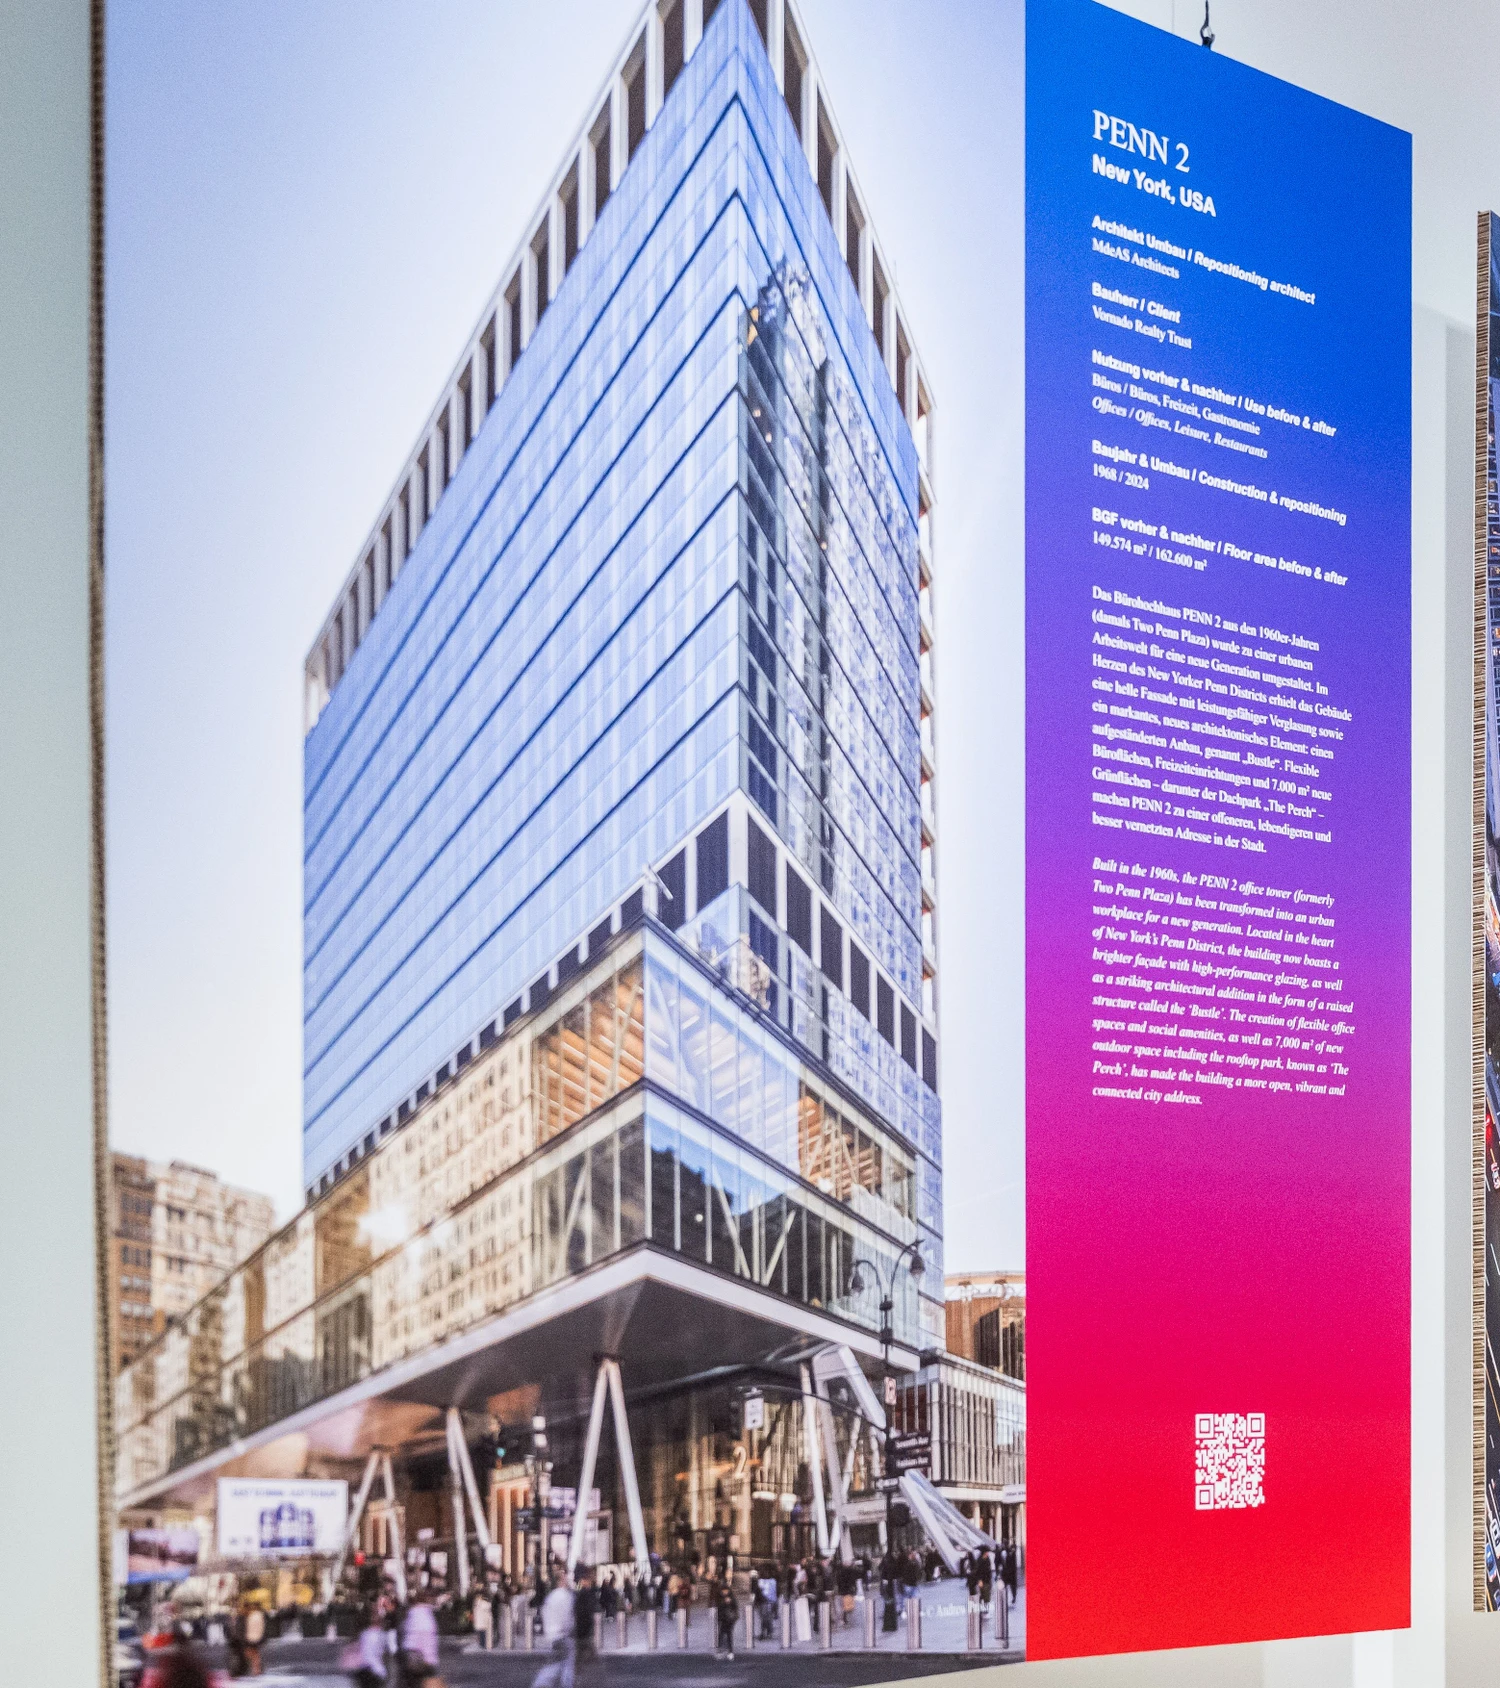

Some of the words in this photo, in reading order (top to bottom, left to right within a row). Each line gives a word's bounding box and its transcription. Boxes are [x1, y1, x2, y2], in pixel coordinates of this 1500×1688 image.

[1093, 109, 1169, 165] PENN
[1175, 142, 1190, 173] 2
[1093, 153, 1130, 184] New
[1133, 168, 1176, 205] York,
[1180, 186, 1216, 217] USA
[1092, 215, 1145, 245] Architekt
[1146, 233, 1186, 260] Umbau
[1194, 251, 1268, 291] Repositioning
[1270, 280, 1315, 305] architect
[1131, 252, 1179, 279] Architects
[1092, 282, 1139, 309] Bauherr
[1147, 301, 1181, 324] Client
[1092, 305, 1133, 330] Vornado
[1135, 319, 1166, 343] Realty
[1167, 329, 1192, 349] Trust
[1092, 349, 1140, 380] Nutzung
[1142, 368, 1179, 388] vorher
[1180, 377, 1190, 392] &
[1192, 384, 1237, 406] nachher
[1244, 397, 1266, 415] Use
[1266, 404, 1301, 426] before
[1302, 416, 1311, 430] &
[1312, 420, 1337, 437] after
[1092, 373, 1122, 394] Büros
[1129, 384, 1161, 407] Büros,
[1163, 394, 1201, 419] Freizeit,
[1202, 407, 1260, 435] Gastronomie
[1092, 396, 1127, 417] Offices
[1135, 409, 1172, 432] Offices,
[1174, 420, 1211, 443] Leisure,
[1213, 432, 1268, 459] Restaurants
[1092, 439, 1137, 464] Baujahr
[1139, 453, 1149, 468] &
[1150, 456, 1190, 480] Umbau
[1198, 470, 1268, 501] Construction
[1269, 491, 1278, 504] &
[1279, 496, 1347, 526] repositioning
[1093, 463, 1117, 481] 1968
[1124, 472, 1149, 490] 2024
[1092, 507, 1118, 526] BGF
[1120, 517, 1158, 536] vorher
[1159, 525, 1169, 540] &
[1171, 531, 1216, 552] nachher
[1223, 542, 1253, 561] Floor
[1253, 553, 1277, 568] area
[1278, 557, 1312, 577] before
[1313, 566, 1322, 580] &
[1324, 570, 1348, 586] after
[1093, 531, 1132, 552] 149.574
[1091, 609, 1131, 629] (damals
[1132, 617, 1154, 634] Two
[1155, 623, 1179, 640] Penn
[1181, 629, 1210, 649] Plaza)
[1211, 639, 1240, 654] wurde
[1241, 646, 1253, 657] zu
[1254, 647, 1277, 662] einer
[1278, 654, 1313, 671] urbanen
[1092, 585, 1112, 602] Das
[1114, 590, 1181, 619] Bürohochhaus
[1183, 607, 1213, 626] PENN
[1215, 615, 1221, 628] 2
[1222, 620, 1239, 632] aus
[1239, 622, 1257, 637] den
[1259, 626, 1319, 651] 1960er-Jahren
[1092, 631, 1148, 655] Arbeitswelt
[1150, 644, 1165, 659] für
[1165, 648, 1186, 663] eine
[1187, 655, 1210, 669] neue
[1211, 658, 1261, 680] Generation
[1262, 672, 1314, 692] umgestaltet.
[1316, 681, 1328, 696] Im
[1092, 653, 1127, 673] Herzen
[1128, 662, 1146, 677] des
[1147, 665, 1170, 681] New
[1171, 671, 1204, 689] Yorker
[1205, 678, 1228, 695] Penn
[1230, 683, 1267, 703] Districts
[1268, 694, 1297, 710] erhielt
[1298, 699, 1313, 713] das
[1314, 703, 1352, 721] Gebäude
[1092, 857, 1118, 872] Built
[1119, 862, 1130, 874] in
[1131, 863, 1147, 877] the
[1149, 866, 1180, 883] 1960s,
[1182, 871, 1198, 885] the
[1199, 874, 1230, 890] PENN
[1230, 879, 1237, 891] 2
[1239, 881, 1264, 896] office
[1266, 886, 1292, 899] tower
[1293, 889, 1335, 909] (formerly
[1093, 879, 1114, 894] Two
[1115, 883, 1141, 898] Penn
[1142, 887, 1174, 905] Plaza)
[1176, 892, 1193, 906] has
[1195, 895, 1217, 910] been
[1219, 901, 1275, 918] transformed
[1275, 908, 1294, 921] into
[1295, 914, 1307, 923] an
[1309, 914, 1335, 927] urban
[1093, 904, 1144, 921] workplace
[1143, 910, 1161, 924] for
[1161, 916, 1169, 925] a
[1170, 917, 1191, 927] new
[1191, 920, 1243, 935] generation.
[1246, 924, 1283, 941] Located
[1284, 931, 1294, 942] in
[1295, 932, 1310, 945] the
[1311, 934, 1335, 948] heart
